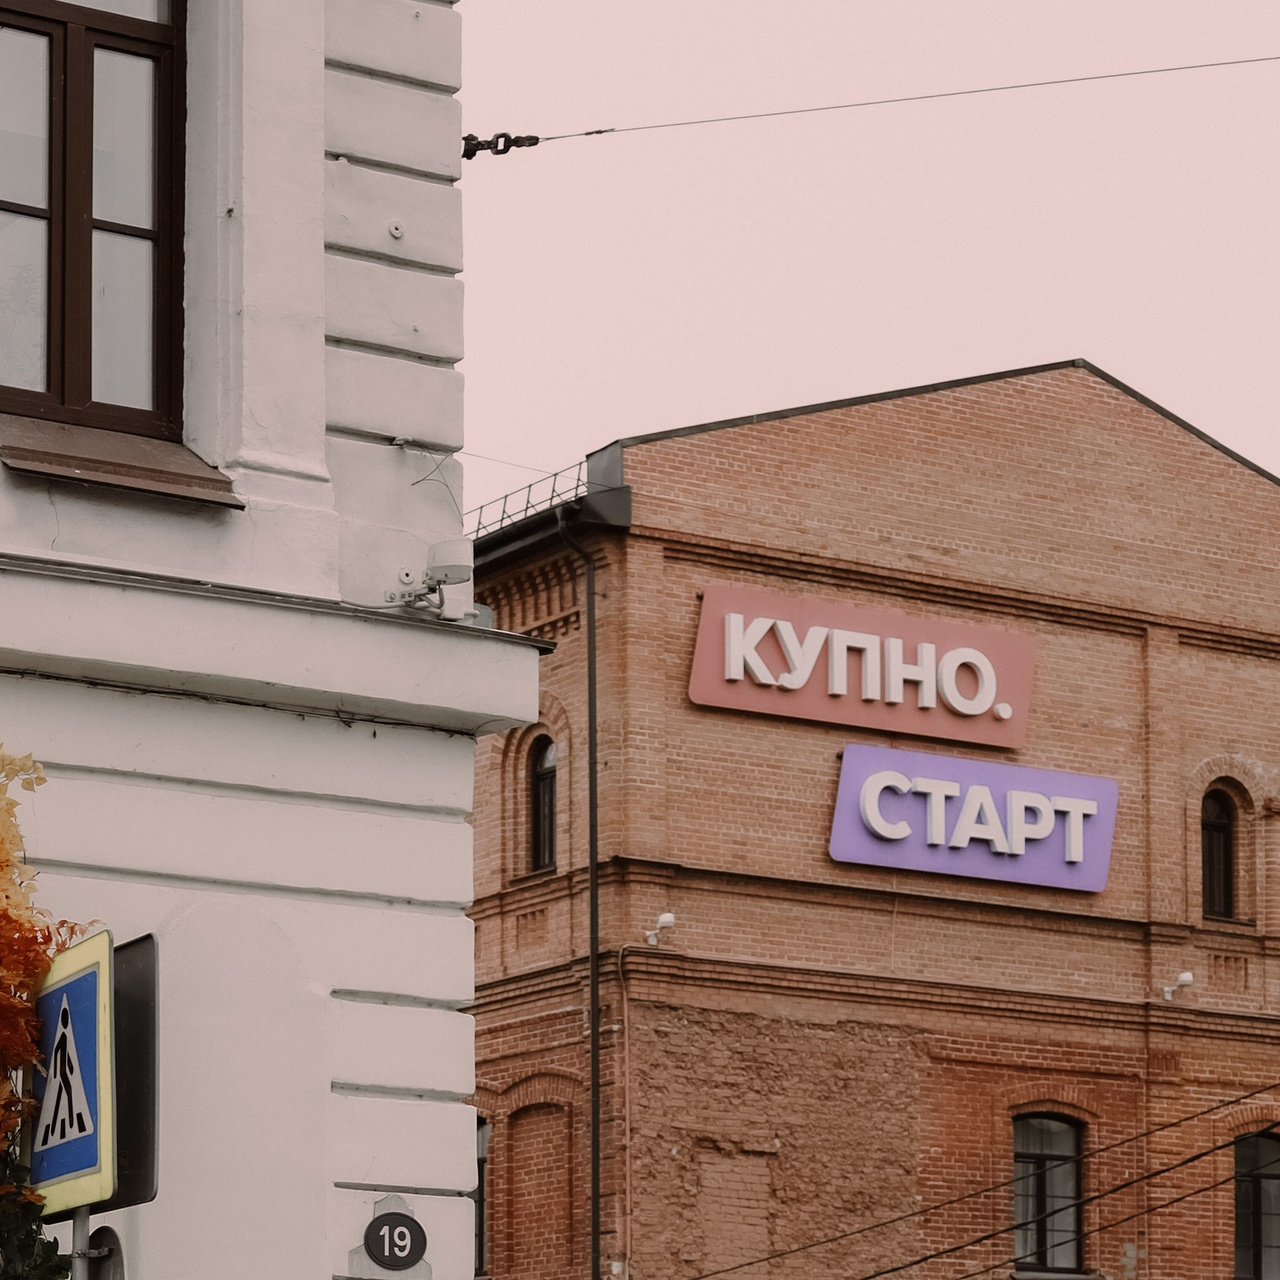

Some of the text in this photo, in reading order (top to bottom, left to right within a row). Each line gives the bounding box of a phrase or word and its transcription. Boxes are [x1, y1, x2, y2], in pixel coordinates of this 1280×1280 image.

[724, 611, 1014, 718] КУПНО.
[859, 769, 1098, 864] СТАРТ
[379, 1225, 412, 1257] 19
